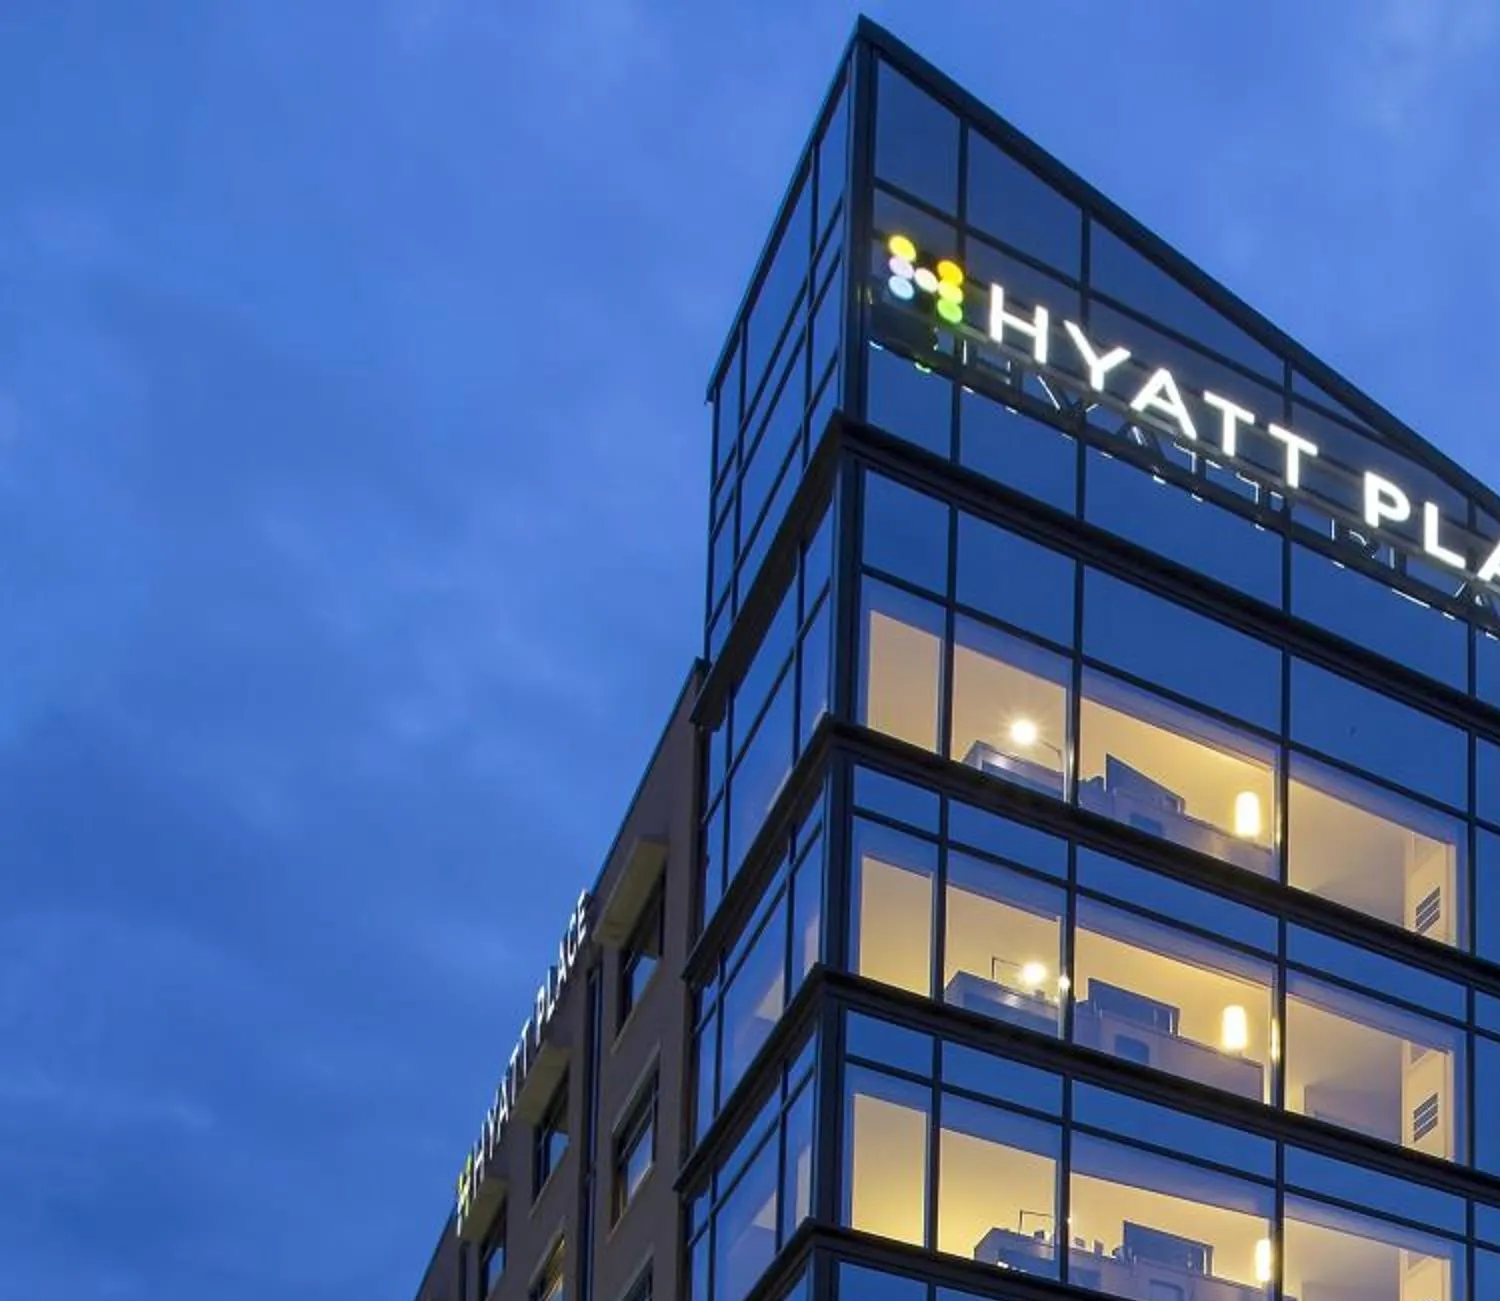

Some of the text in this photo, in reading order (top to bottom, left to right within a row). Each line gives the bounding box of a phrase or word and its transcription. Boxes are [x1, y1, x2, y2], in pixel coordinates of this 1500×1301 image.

[989, 284, 1317, 488] HYATT
[472, 889, 587, 1199] HYATT PLACE
